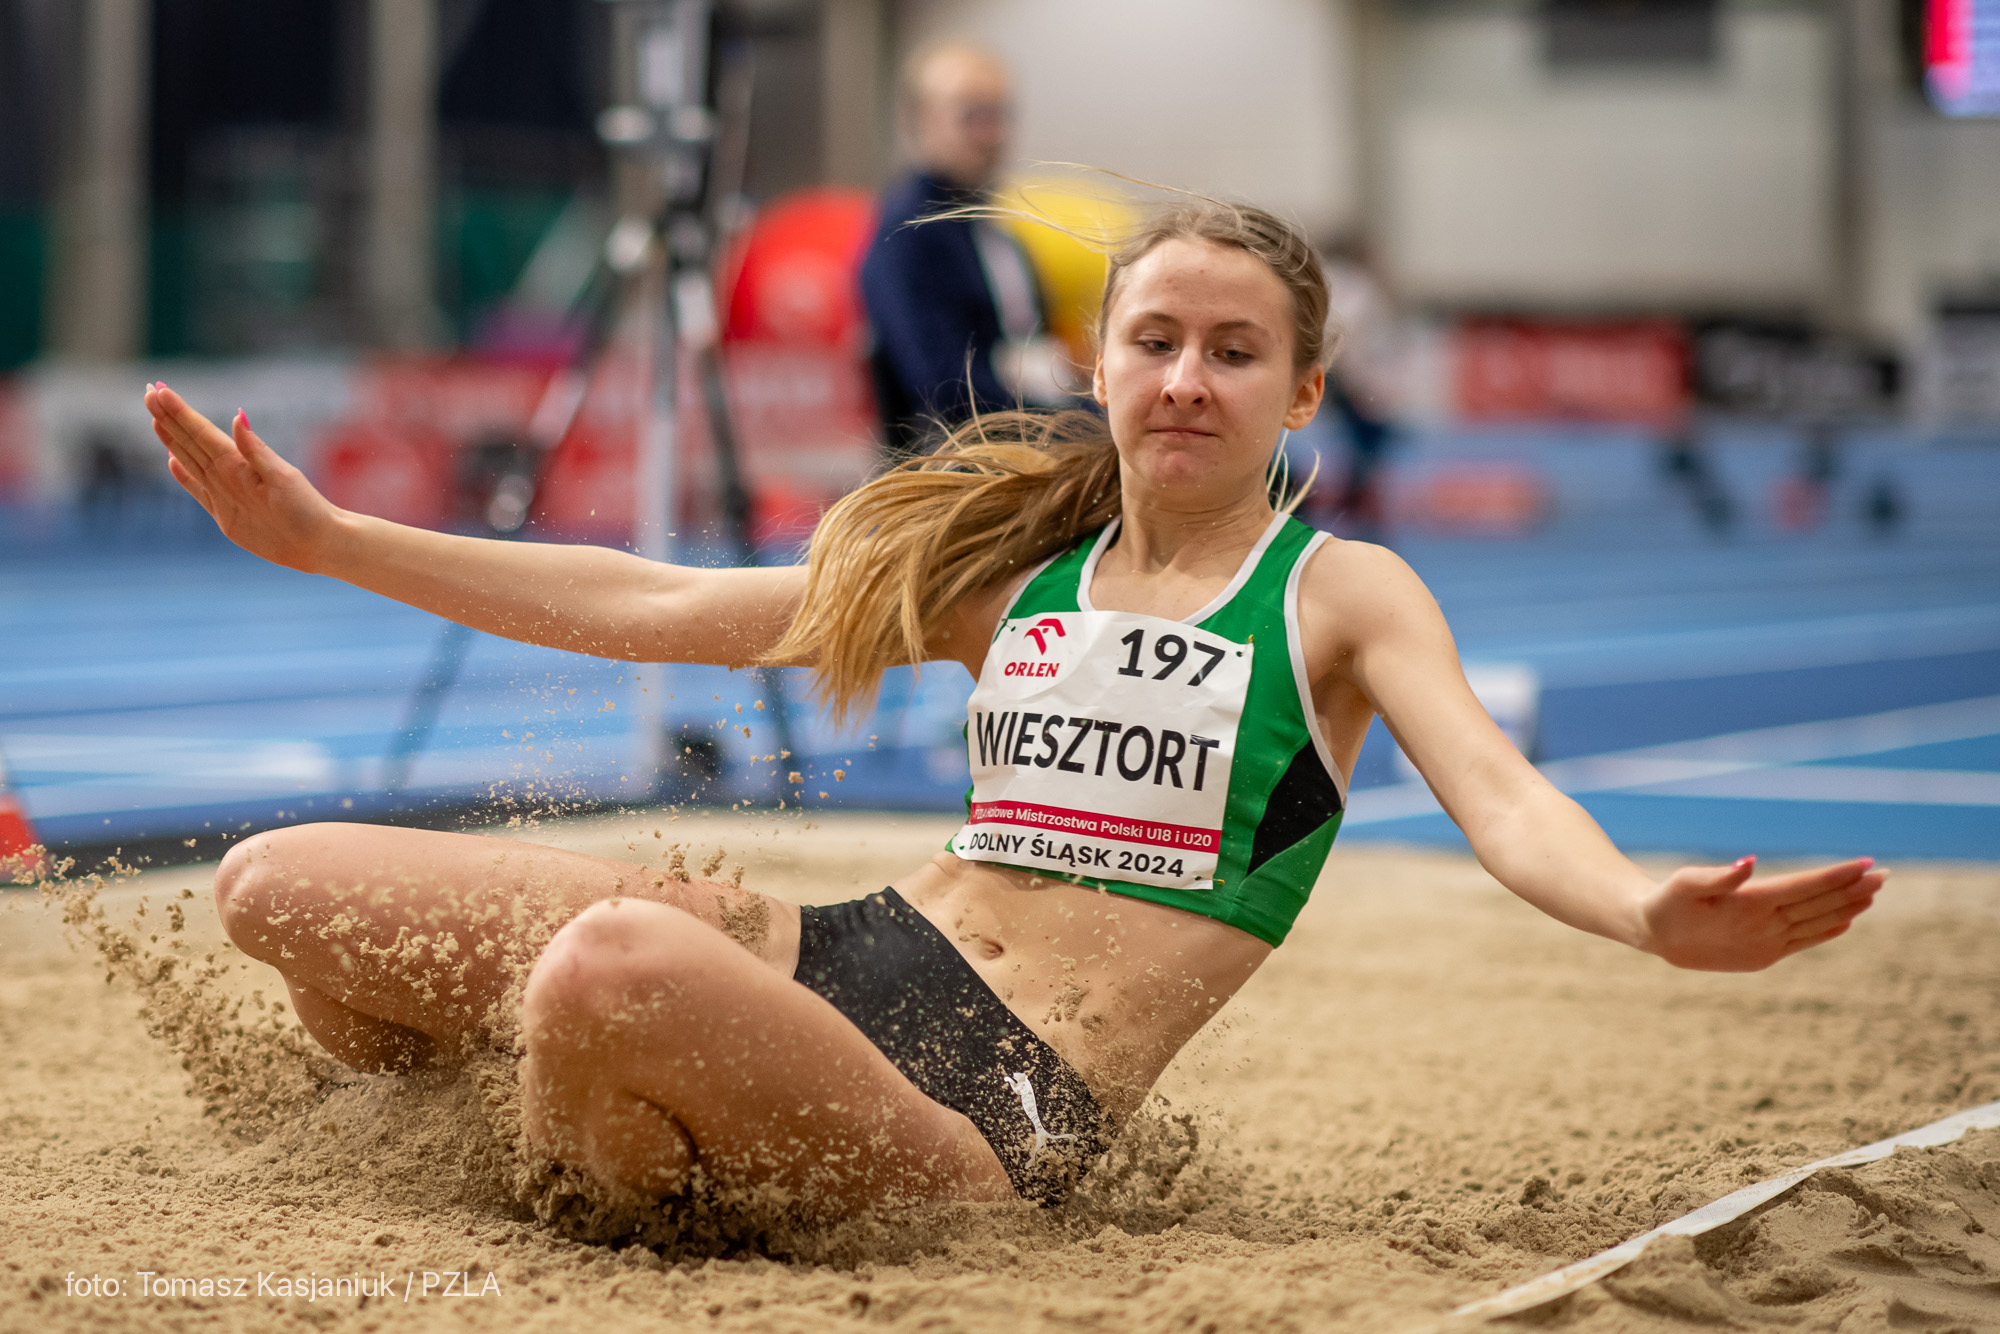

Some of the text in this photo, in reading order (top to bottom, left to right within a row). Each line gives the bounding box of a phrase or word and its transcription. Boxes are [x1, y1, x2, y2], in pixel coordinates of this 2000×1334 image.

[1004, 662, 1060, 678] ORLEN
[1117, 629, 1226, 687] 197
[976, 711, 1220, 792] WIESZTORT
[1015, 808, 1098, 832] Mistrzostwa
[1100, 820, 1144, 838] Polski
[1146, 827, 1172, 842] U18
[1175, 830, 1180, 843] i
[1183, 833, 1213, 848] U20
[969, 832, 1184, 878] DOLNY ŚLĄSK 2024
